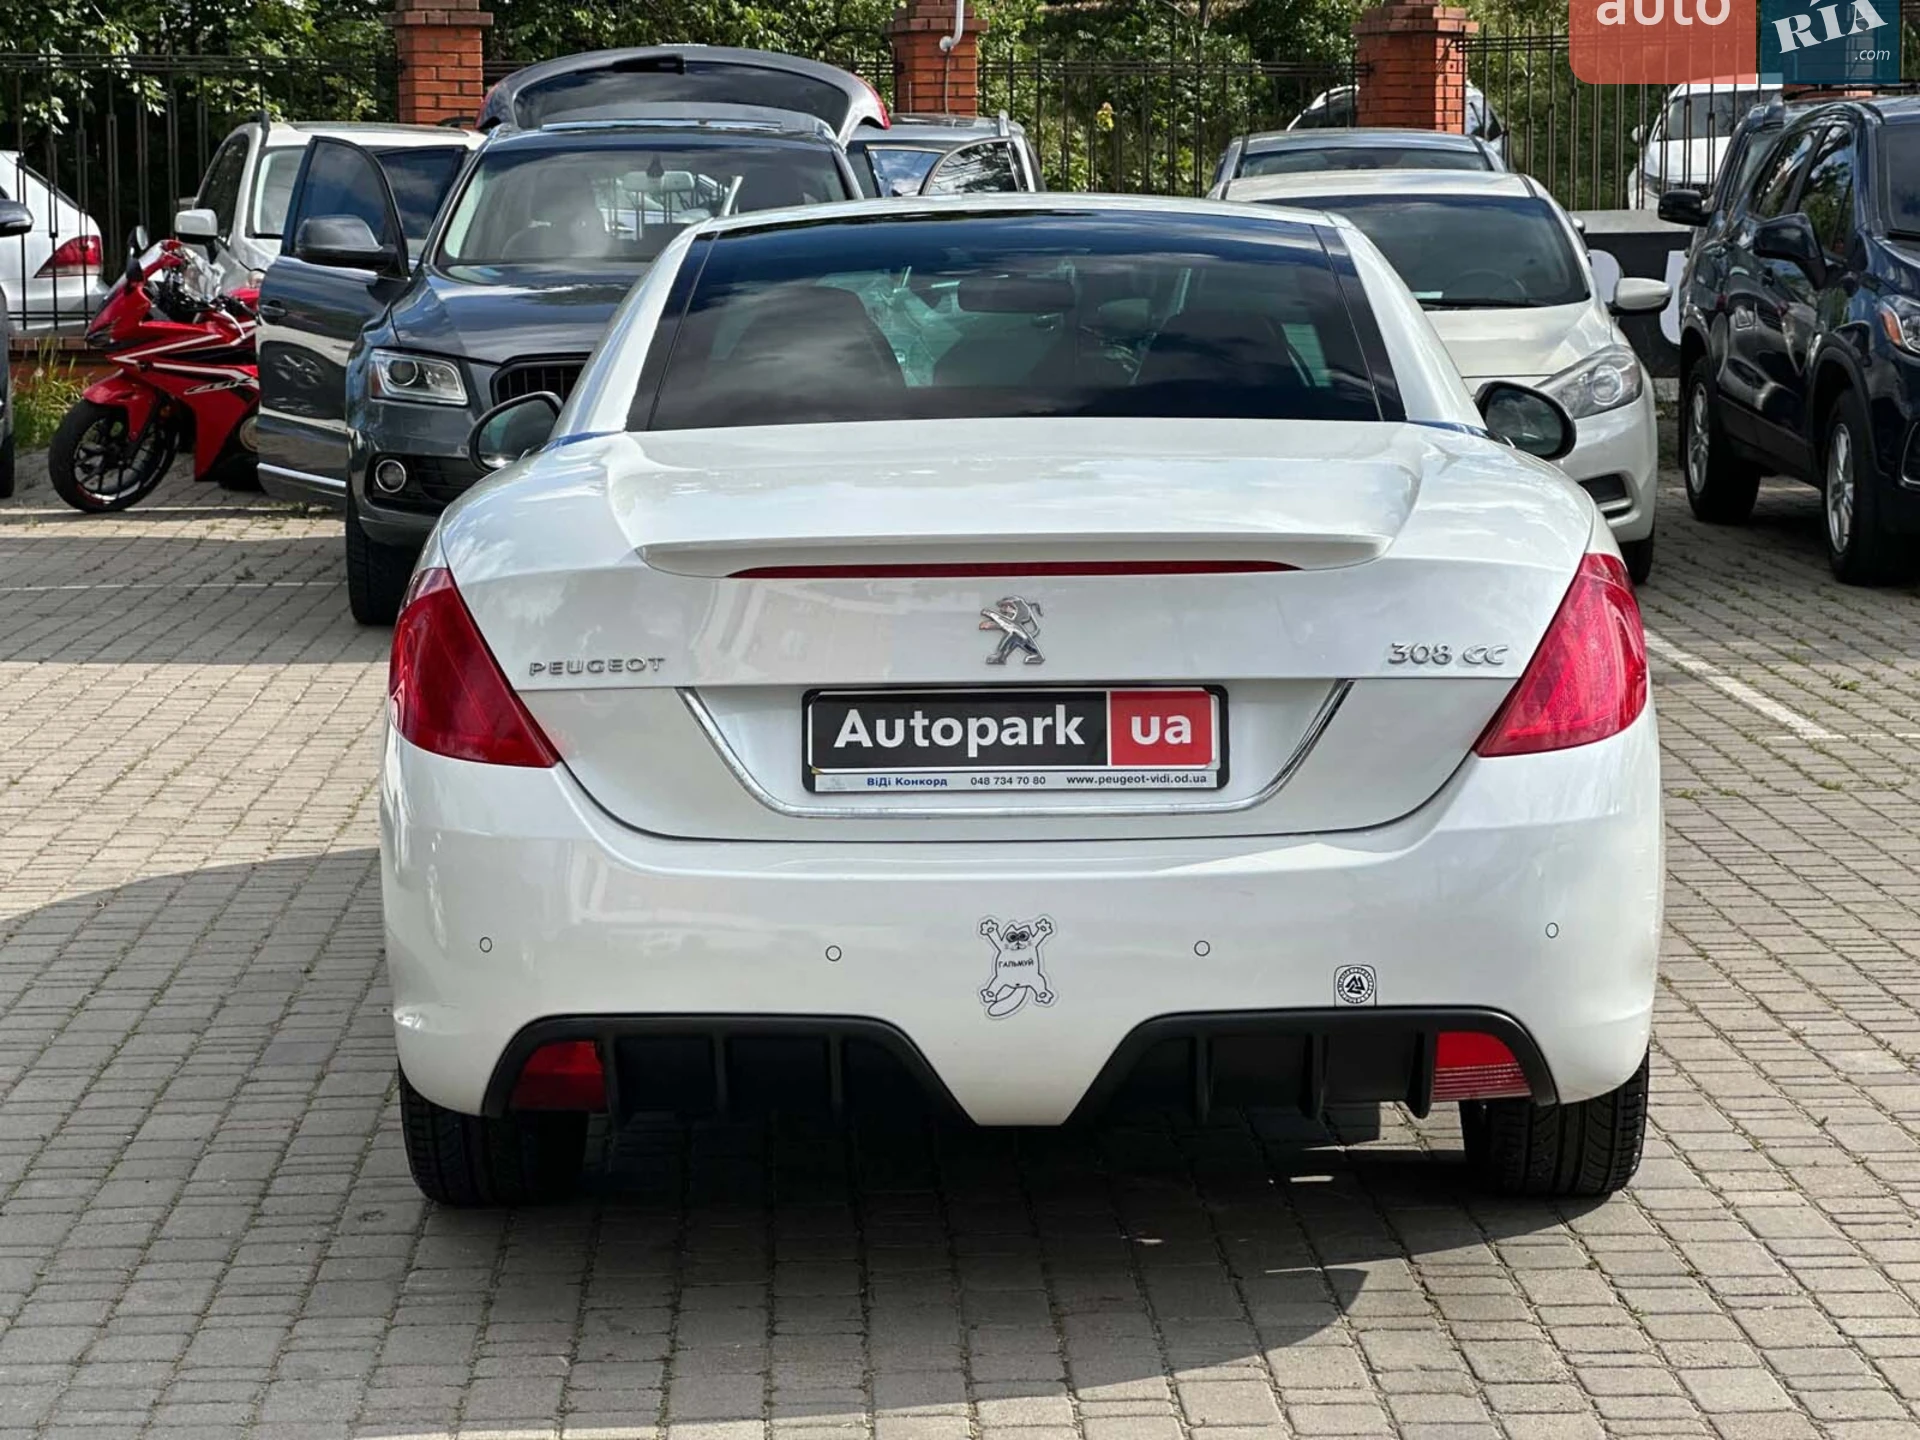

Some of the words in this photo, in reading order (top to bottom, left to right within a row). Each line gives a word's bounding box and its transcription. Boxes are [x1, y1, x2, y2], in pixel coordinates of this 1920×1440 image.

[1388, 643, 1453, 666] 308
[1462, 645, 1508, 666] CC
[529, 658, 666, 677] PEUGEOT
[833, 704, 1085, 758] Autopark
[1131, 714, 1192, 745] ua
[895, 777, 948, 788] Конкорд
[970, 776, 990, 786] 048
[993, 776, 1013, 786] 734
[1017, 776, 1030, 785] 70
[1033, 776, 1046, 785] 80
[1066, 774, 1207, 786] www.peugeot-vidi.od.ua
[998, 957, 1035, 969] ГАЛЬМУЙ
